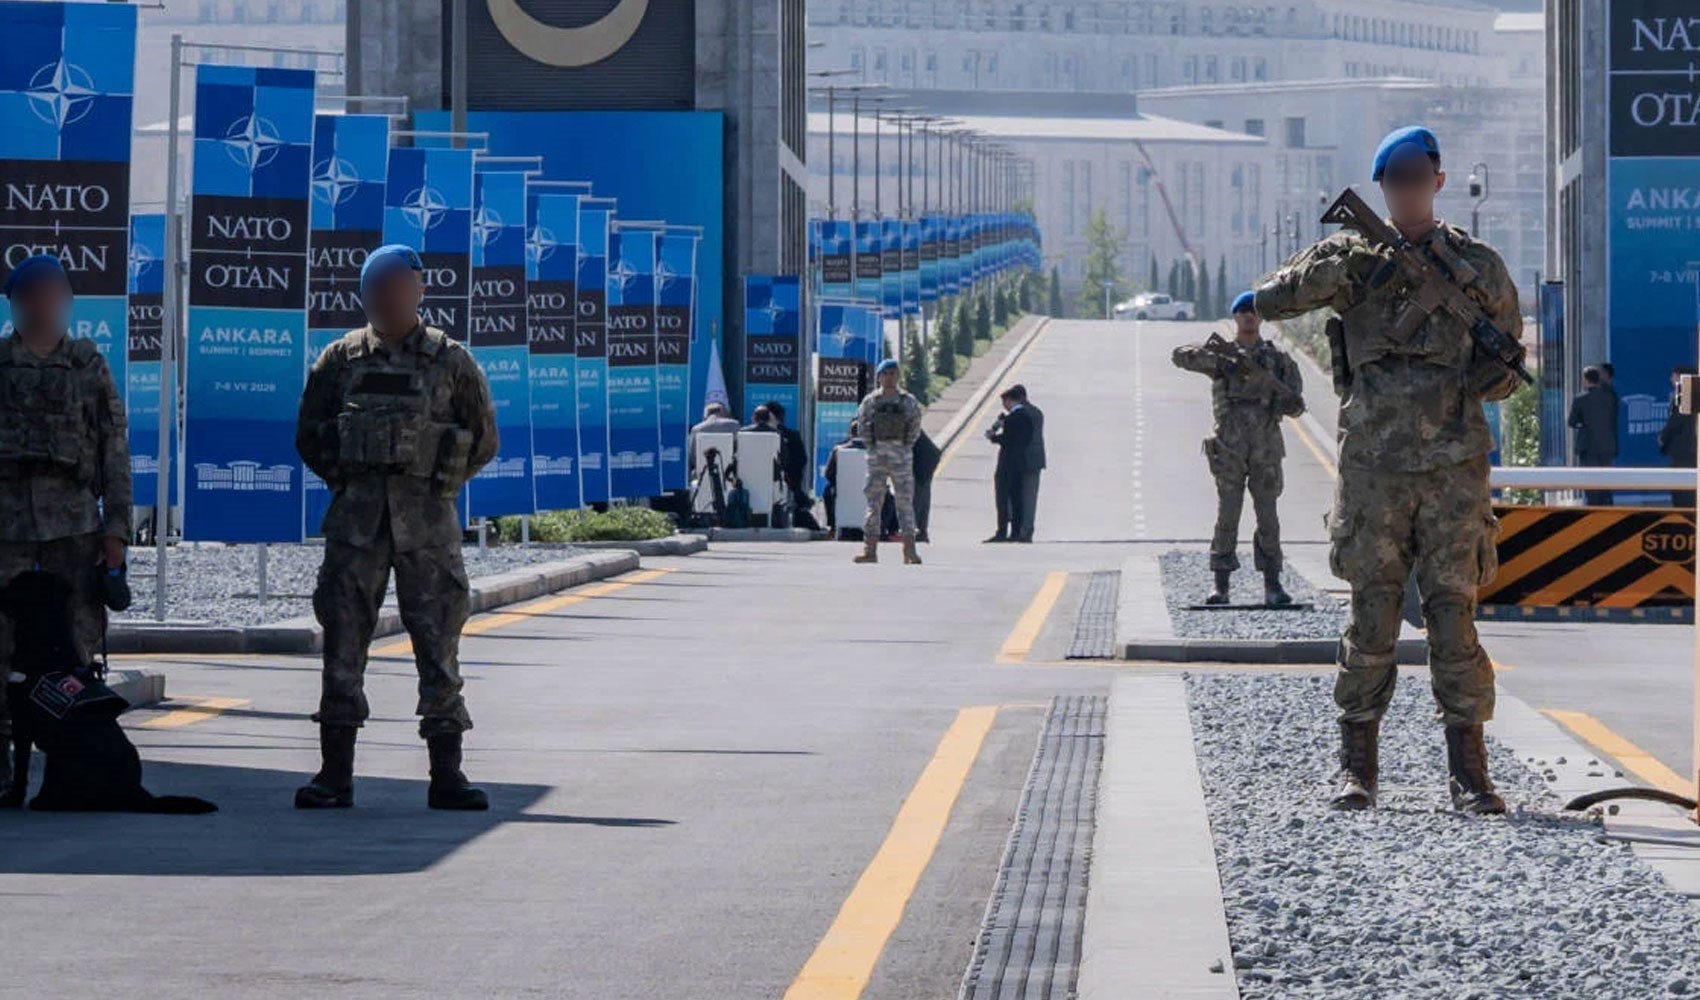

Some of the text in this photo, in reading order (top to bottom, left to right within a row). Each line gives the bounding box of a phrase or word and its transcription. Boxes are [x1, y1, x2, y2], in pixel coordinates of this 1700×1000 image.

[1632, 17, 1700, 51] NA
[1631, 92, 1700, 126] OT
[5, 183, 109, 212] NATO
[1627, 188, 1700, 210] ANK
[207, 215, 292, 241] NATO
[1627, 217, 1681, 229] SUMMIT
[205, 264, 291, 290] OTAN
[421, 268, 456, 287] TO
[472, 280, 515, 298] ATO
[528, 293, 566, 310] ATO
[129, 305, 163, 320] ATO
[472, 315, 516, 333] TAN
[200, 326, 293, 345] ANKARA
[753, 343, 792, 355] NATO
[752, 365, 792, 377] OTAN
[824, 364, 859, 377] NATO
[823, 384, 858, 397] OTAN
